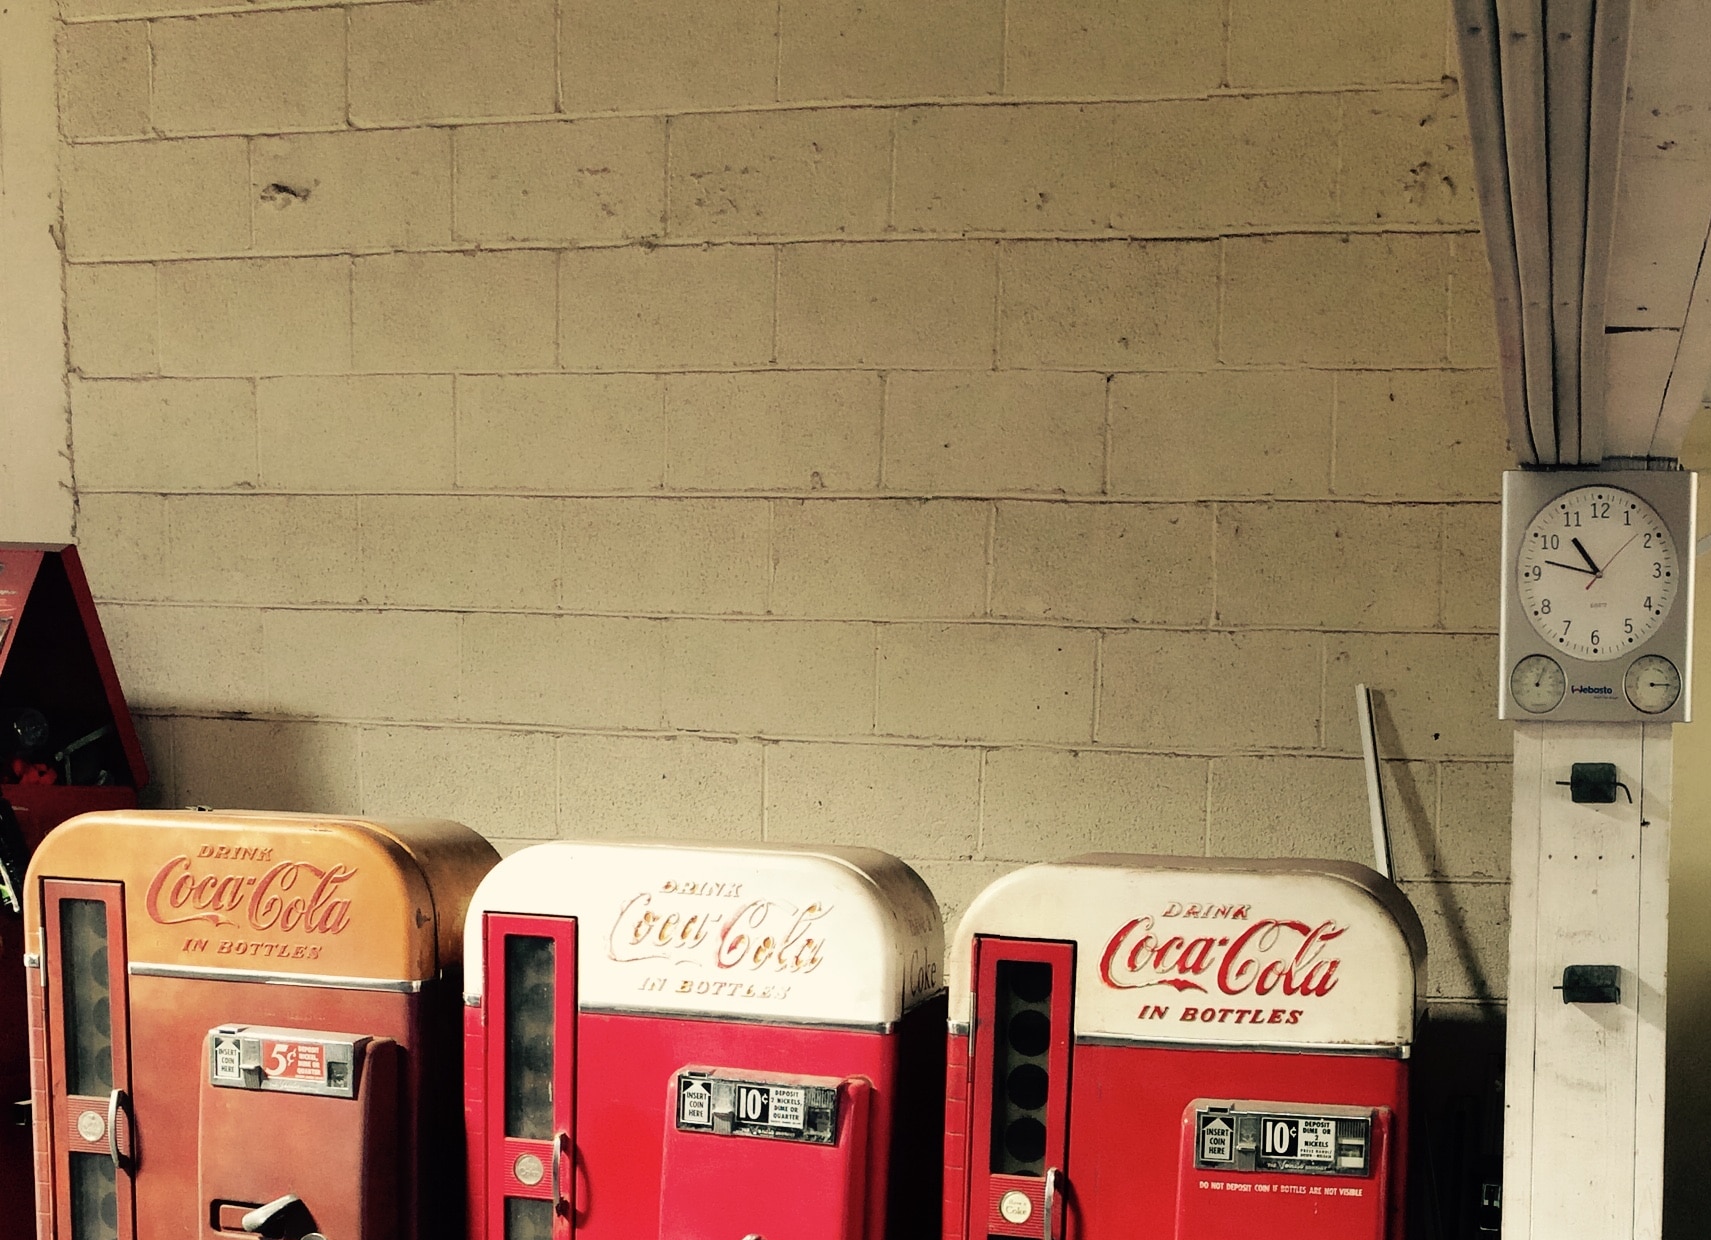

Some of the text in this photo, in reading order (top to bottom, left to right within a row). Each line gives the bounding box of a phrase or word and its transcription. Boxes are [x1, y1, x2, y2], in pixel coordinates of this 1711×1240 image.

[1590, 502, 1610, 519] 12
[1623, 511, 1631, 525] 1
[1563, 511, 1582, 527] 11
[1541, 534, 1560, 550] 10
[1643, 533, 1652, 548] 2
[1532, 565, 1542, 581] 9
[1652, 562, 1662, 578] 3
[1541, 599, 1551, 614] 8
[1643, 596, 1653, 611] 4
[1562, 620, 1572, 636] 7
[1624, 618, 1633, 634] 5
[1590, 630, 1600, 646] 6
[1571, 685, 1613, 695] Webasto
[197, 844, 273, 861] DRINK
[146, 854, 358, 934] Coca-Cola
[659, 880, 743, 898] DRINK
[1162, 902, 1251, 920] DRINK
[608, 892, 834, 974] Coca-Cola
[182, 938, 323, 960] IN BOTTLES
[1098, 914, 1350, 997] Coca-Cola
[638, 977, 791, 1000] IN BOTTLES
[1138, 1005, 1304, 1025] IN BOTTLES
[219, 1048, 237, 1056] INSERT
[221, 1065, 234, 1073] HERE
[687, 1092, 707, 1101] INSERT
[775, 1090, 799, 1098] DEPOSIT
[688, 1109, 704, 1117] HERE
[689, 1101, 704, 1109] COIN
[1206, 1128, 1229, 1138] INSERT
[1209, 1138, 1226, 1146] COIN
[1208, 1146, 1225, 1155] HERE
[1199, 1181, 1209, 1189] DO
[1211, 1182, 1224, 1190] NOT
[1226, 1183, 1252, 1192] DEPOSIT
[1254, 1184, 1270, 1192] COIN
[1280, 1185, 1306, 1194] BOTTLES
[1309, 1186, 1322, 1195] ARE
[1324, 1187, 1337, 1196] NOT
[1339, 1188, 1363, 1197] VISIBLE
